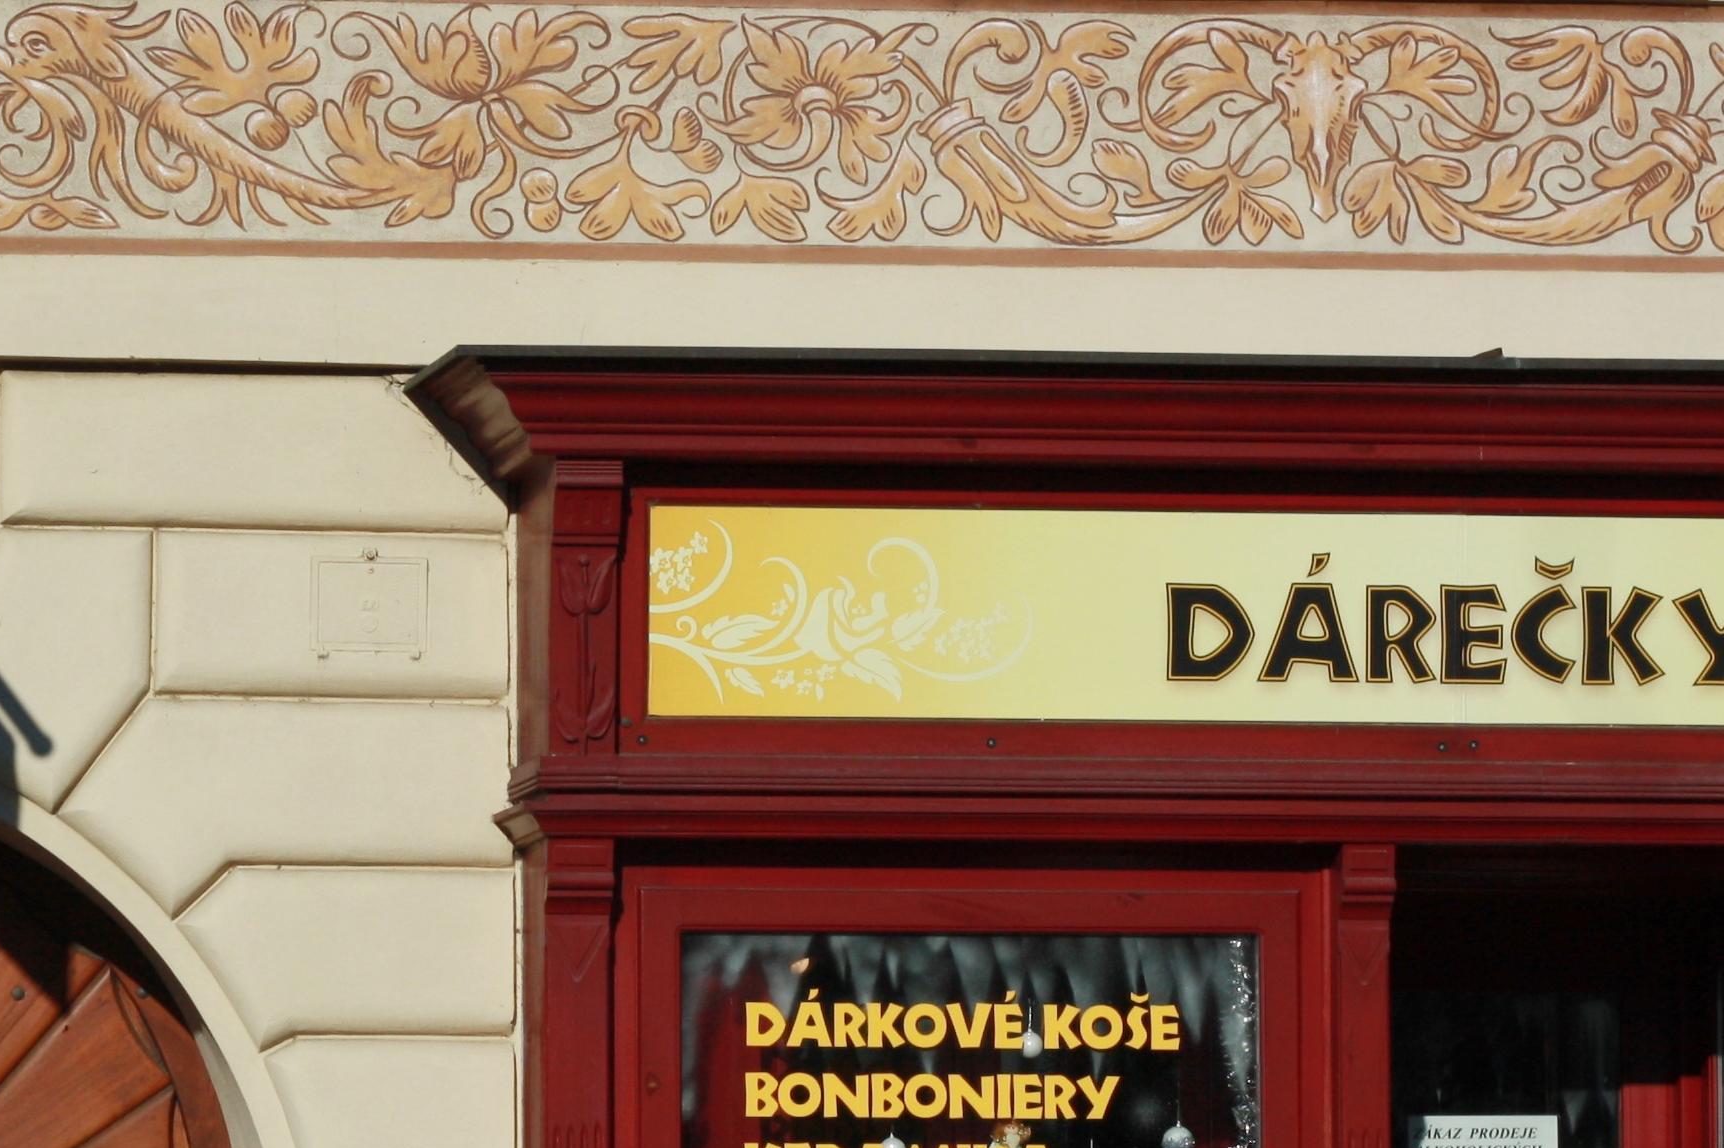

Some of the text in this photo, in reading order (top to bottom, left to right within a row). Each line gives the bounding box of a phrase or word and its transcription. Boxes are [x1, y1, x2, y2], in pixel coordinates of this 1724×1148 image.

[744, 988, 1181, 1051] DÁRKOVÉ KOŠE
[744, 1072, 1121, 1120] BONBONIERY
[1469, 1127, 1538, 1139] PRODEJE
